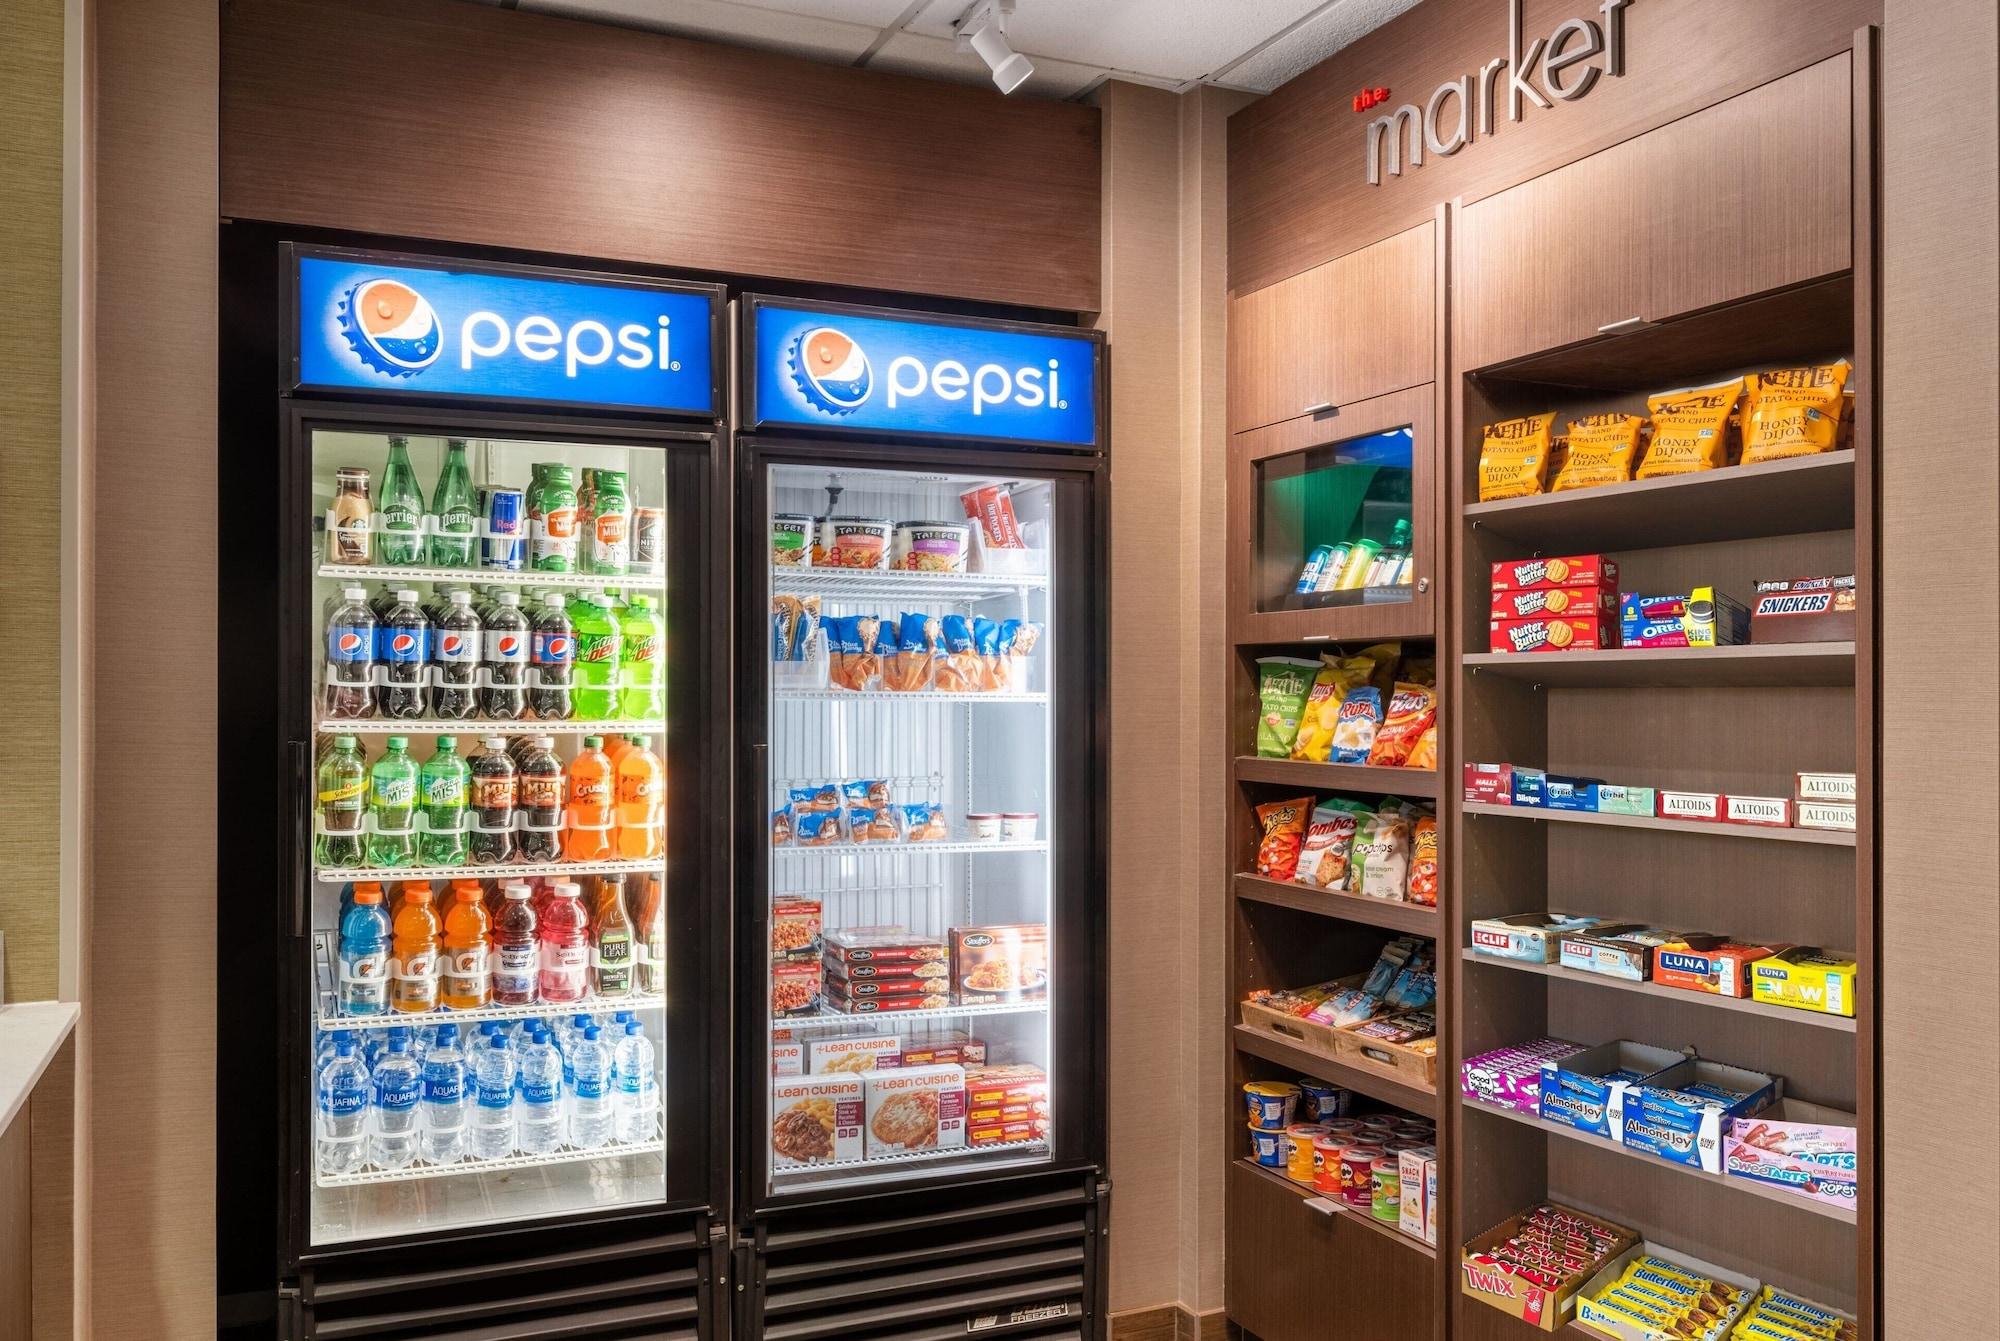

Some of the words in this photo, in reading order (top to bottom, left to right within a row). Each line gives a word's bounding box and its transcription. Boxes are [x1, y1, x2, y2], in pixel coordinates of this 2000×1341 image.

[1353, 86, 1391, 112] the
[1367, 0, 1635, 185] market
[461, 314, 671, 379] pepsi
[886, 357, 1060, 417] pepsi
[1756, 395, 1793, 404] OTATO
[1688, 416, 1718, 425] CHIPS
[1759, 416, 1810, 431] HONEY
[1764, 426, 1808, 440] DIJON
[1571, 451, 1613, 460] HONEY
[1655, 447, 1694, 457] DIJON
[1573, 458, 1610, 466] DIJON
[1485, 465, 1525, 474] HONEY
[1488, 473, 1520, 483] DIJON
[385, 509, 418, 527] errier
[496, 519, 516, 529] Red
[1514, 561, 1544, 578] Nutter
[1519, 568, 1548, 587] Butter
[1513, 591, 1544, 608] Nutter
[1759, 595, 1829, 614] SNICKERS
[1519, 598, 1547, 616] Butter
[1508, 621, 1544, 640] Nutter
[1643, 623, 1685, 638] OREO
[1687, 628, 1712, 636] KING
[1514, 630, 1549, 651] Butter
[1279, 704, 1299, 713] CHIPS
[1475, 778, 1498, 786] HALLS
[1806, 780, 1856, 793] ALTOIDS
[386, 788, 410, 805] MIS
[1516, 793, 1541, 804] Blistex
[1600, 788, 1625, 801] Orbit
[1668, 799, 1712, 811] ALTOIDS
[1734, 803, 1780, 816] ALTOIDS
[1805, 809, 1856, 822] ALTOIDS
[1308, 816, 1358, 837] ombos
[604, 942, 626, 951] PURE
[1481, 933, 1507, 946] CLIF
[1570, 945, 1591, 956] CLIF
[1665, 955, 1705, 970] LUNA
[1760, 969, 1786, 978] LUNA
[775, 1048, 798, 1058] sine
[824, 1042, 854, 1053] Lean
[854, 1039, 896, 1049] cuisine
[883, 1079, 913, 1091] Lean
[915, 1072, 960, 1085] cuisine
[1469, 1072, 1490, 1085] Good
[777, 1086, 809, 1098] Lean
[811, 1083, 858, 1096] cuisine
[322, 1095, 362, 1107] AQUAFINA
[1545, 1092, 1583, 1112] Almond
[1584, 1104, 1602, 1119] Joy
[1626, 1118, 1670, 1141] Almond
[1670, 1132, 1692, 1148] Joy
[1700, 1137, 1715, 1145] KING
[1728, 1157, 1811, 1182] SweeTARTS
[1819, 1181, 1857, 1198] ROPES
[1462, 1262, 1517, 1298] Twix
[1633, 1268, 1699, 1296] Butterfinger
[1010, 1308, 1062, 1323] FREEZER
